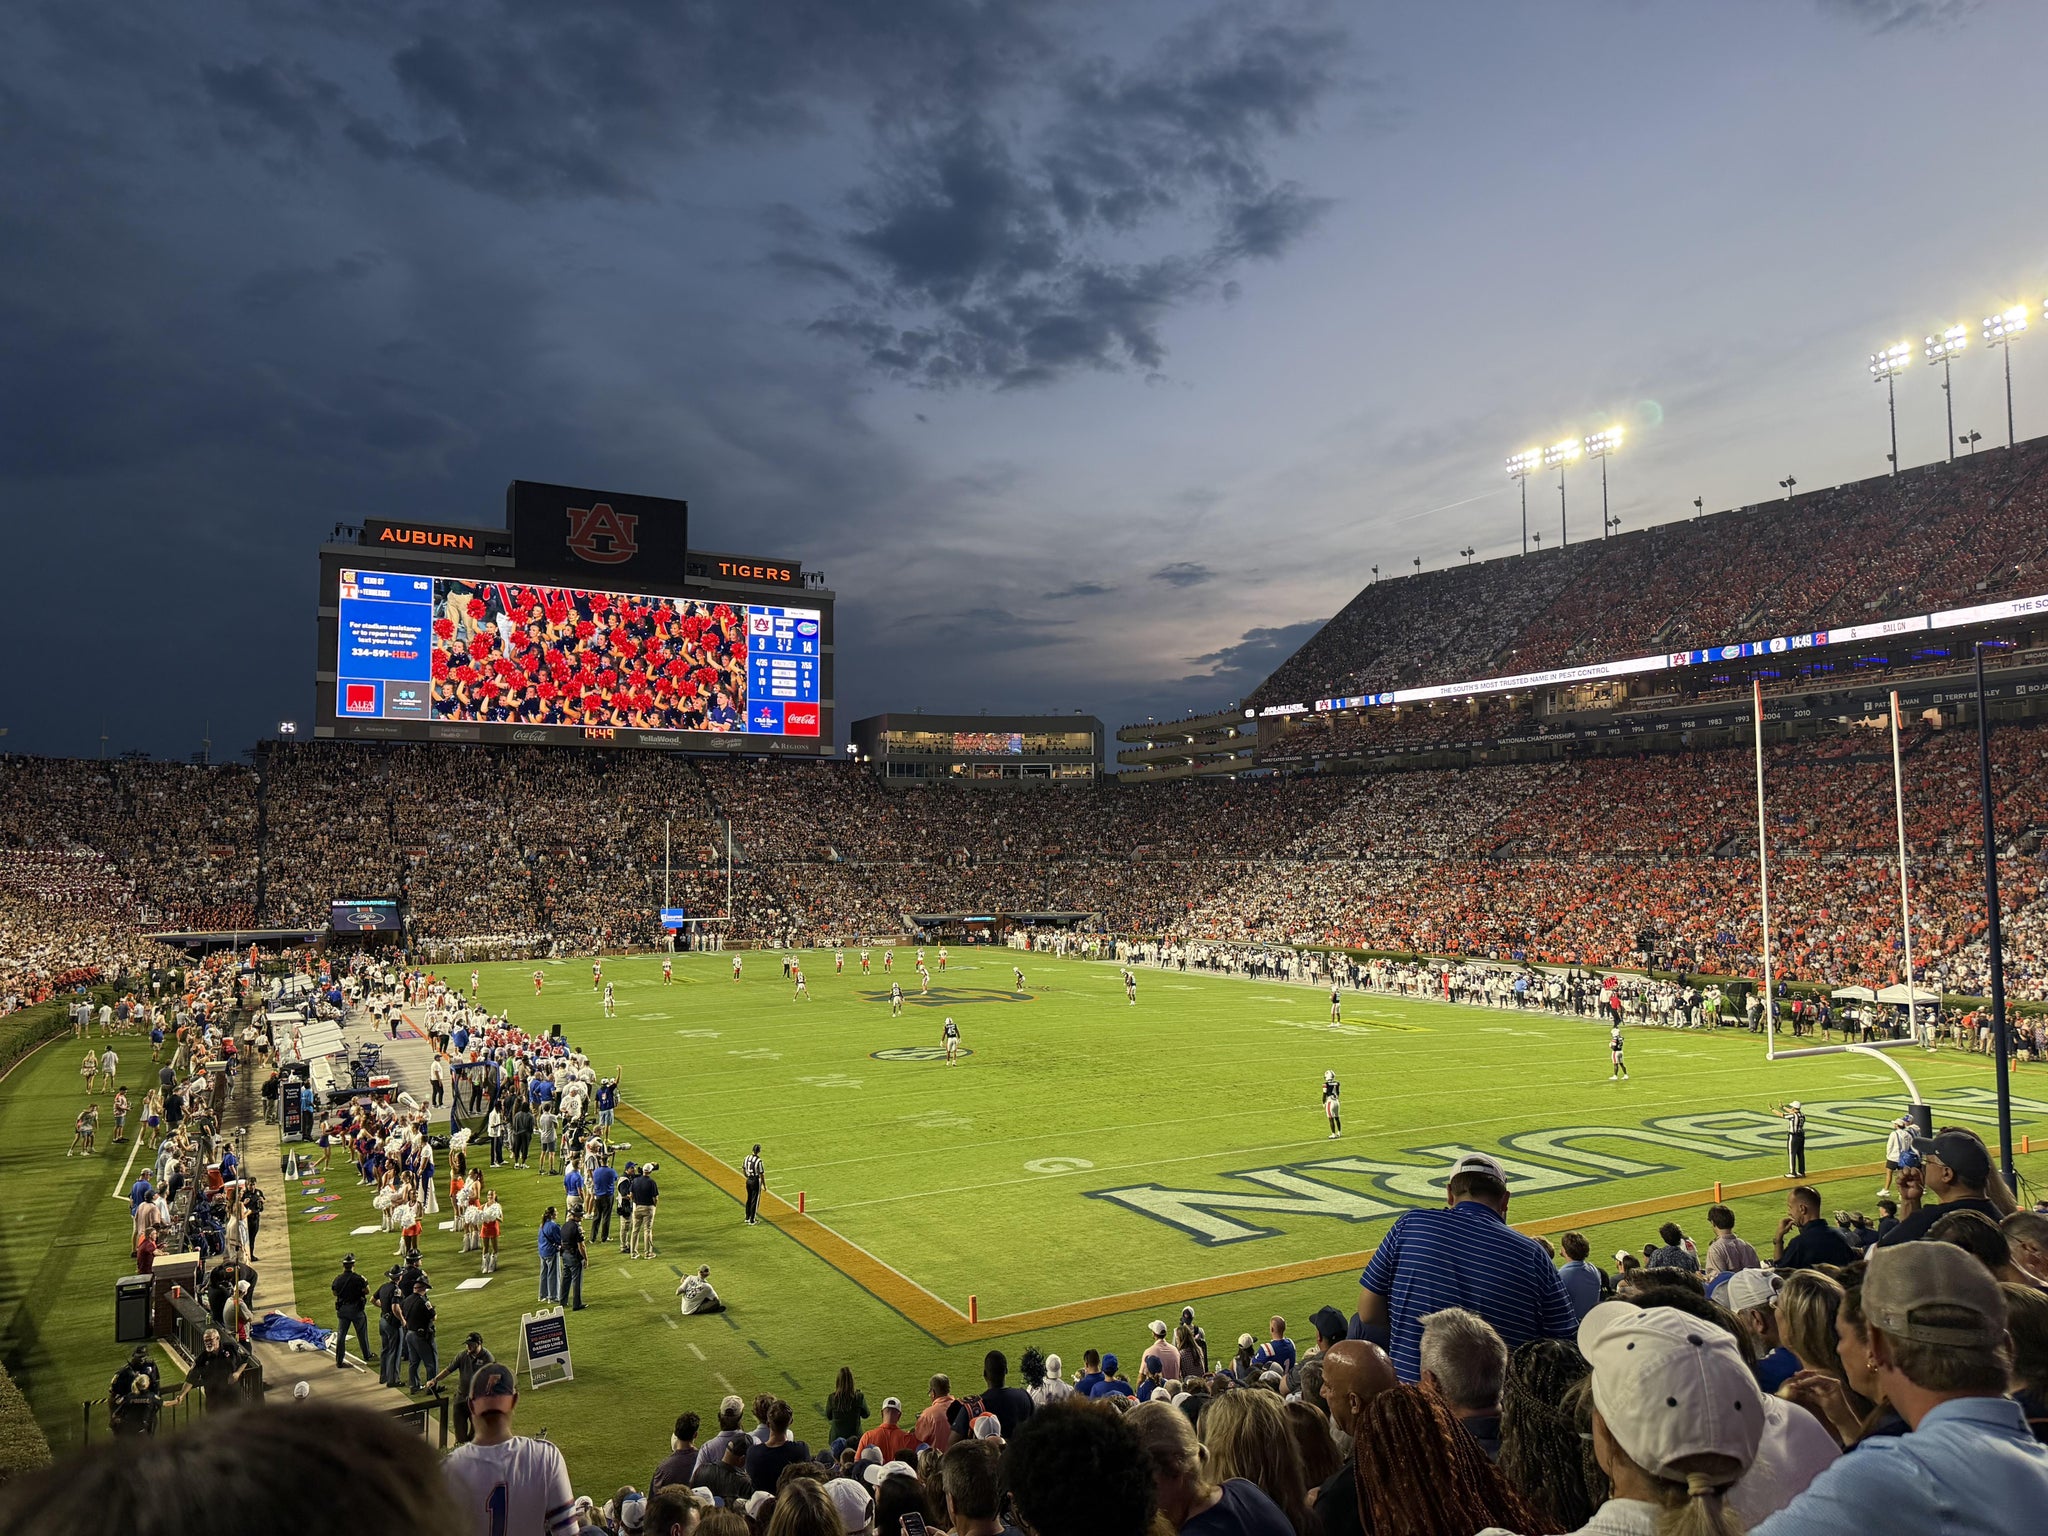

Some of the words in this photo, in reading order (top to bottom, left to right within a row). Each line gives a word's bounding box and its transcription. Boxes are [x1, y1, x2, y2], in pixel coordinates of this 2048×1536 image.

[380, 528, 474, 549] AUBURN
[719, 562, 791, 581] TIGERS
[343, 585, 355, 597] T
[2012, 601, 2032, 612] THE
[368, 630, 389, 638] report
[388, 624, 421, 632] assistance
[1850, 628, 1857, 638] &
[1883, 623, 1896, 633] BALL
[1897, 621, 1906, 631] ON
[351, 647, 418, 658] 334-591-HELP
[803, 641, 812, 653] 14
[1702, 649, 1708, 662] 3
[1752, 641, 1763, 655] 14
[1791, 634, 1812, 648] 14:49
[1816, 633, 1827, 645] 25
[1440, 687, 1452, 695] THE
[1453, 683, 1479, 693] SOUTH'S
[1480, 680, 1499, 690] MOST
[1500, 677, 1529, 687] TRUSTED
[1529, 674, 1549, 683] NAME
[1550, 673, 1557, 681] IN
[1559, 671, 1576, 679] PEST
[1577, 666, 1610, 677] CONTROL
[788, 714, 816, 724] Coca-Cola
[584, 728, 614, 740] 14:49
[1498, 736, 1526, 745] NATIONAL
[1526, 732, 1576, 743] CHAMPIONSHIPS
[1708, 718, 1722, 726] 1983
[1735, 715, 1750, 723] 1993
[1763, 712, 1781, 720] 2004
[512, 730, 547, 742] Coca-Cola
[639, 735, 680, 743] YellaWood
[532, 1344, 550, 1352] DASHED
[486, 1482, 509, 1536] 1
